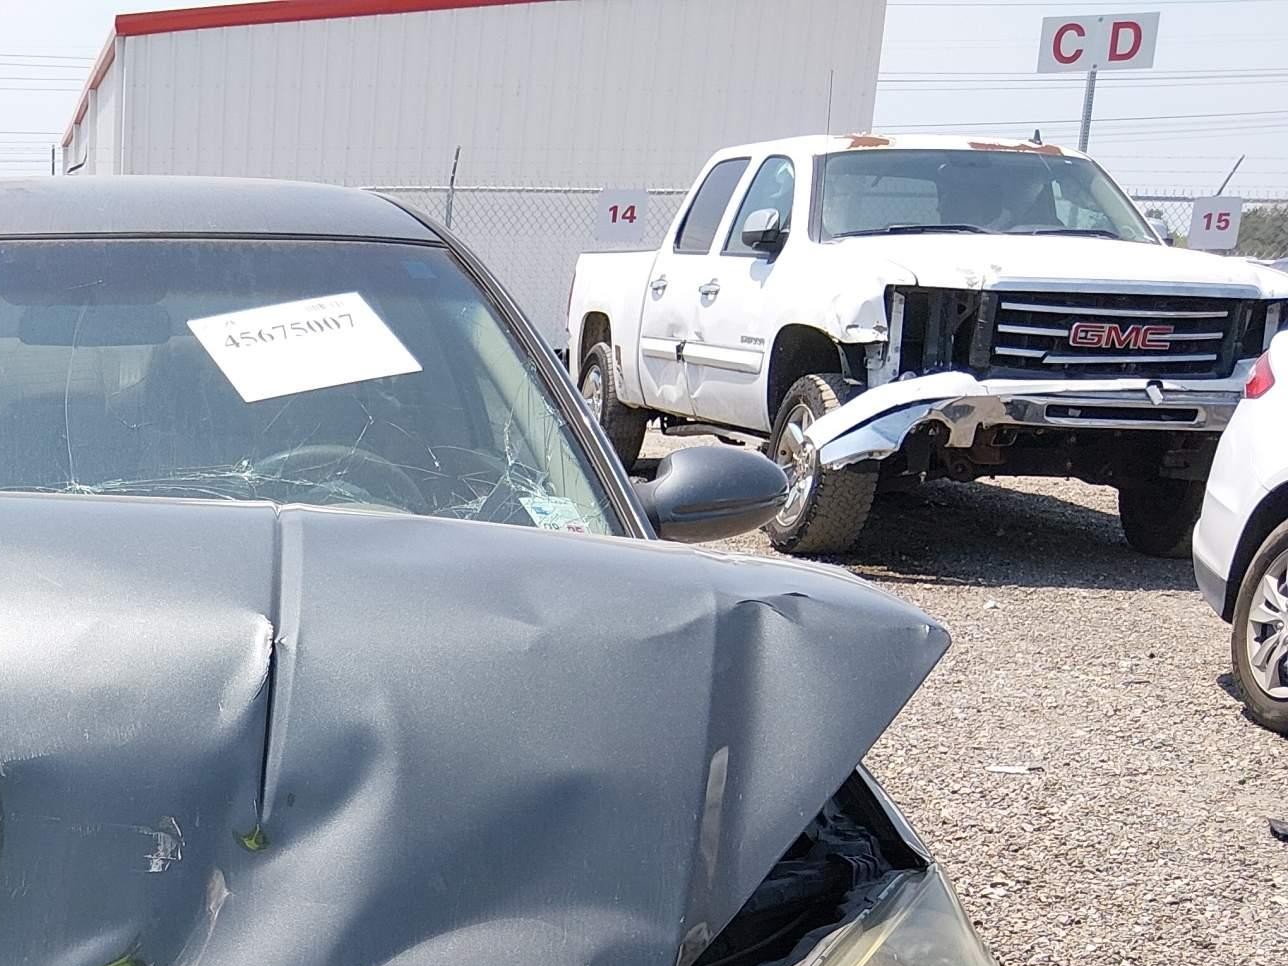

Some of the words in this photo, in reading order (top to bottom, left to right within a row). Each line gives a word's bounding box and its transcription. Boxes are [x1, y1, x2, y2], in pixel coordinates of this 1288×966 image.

[1052, 23, 1085, 64] C
[1108, 21, 1142, 61] D
[609, 205, 636, 223] 14
[1203, 212, 1230, 231] 15
[224, 312, 355, 348] 45675007
[1069, 322, 1174, 350] GMC
